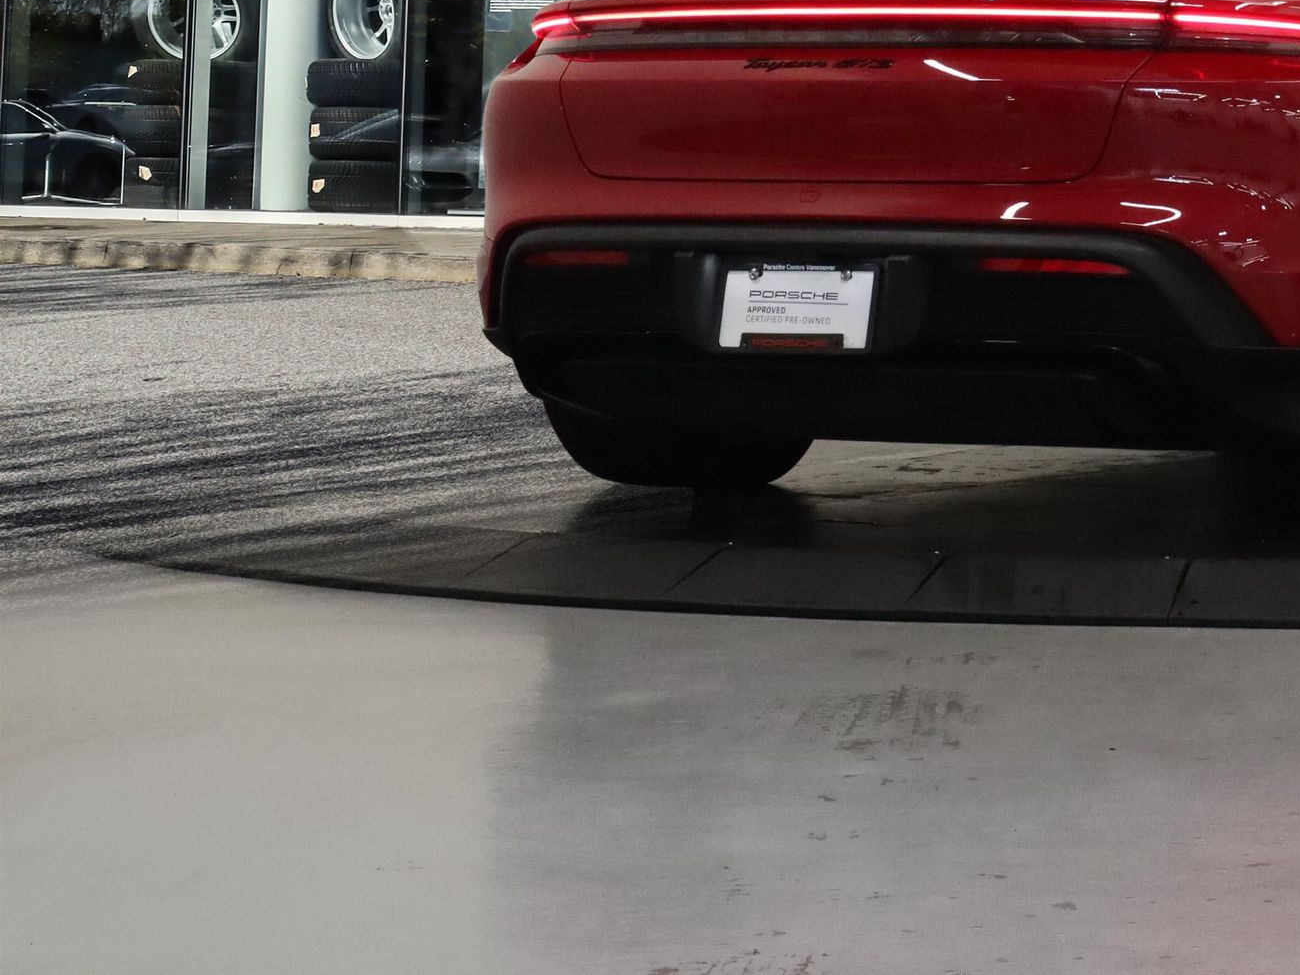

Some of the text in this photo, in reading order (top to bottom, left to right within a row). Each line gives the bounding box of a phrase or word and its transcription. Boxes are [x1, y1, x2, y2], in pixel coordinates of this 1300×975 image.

[744, 57, 828, 72] Taycan
[749, 290, 838, 300] PORSCHE
[747, 306, 786, 314] APPROVED
[745, 315, 831, 325] CERTIFIED PRE-OWNED
